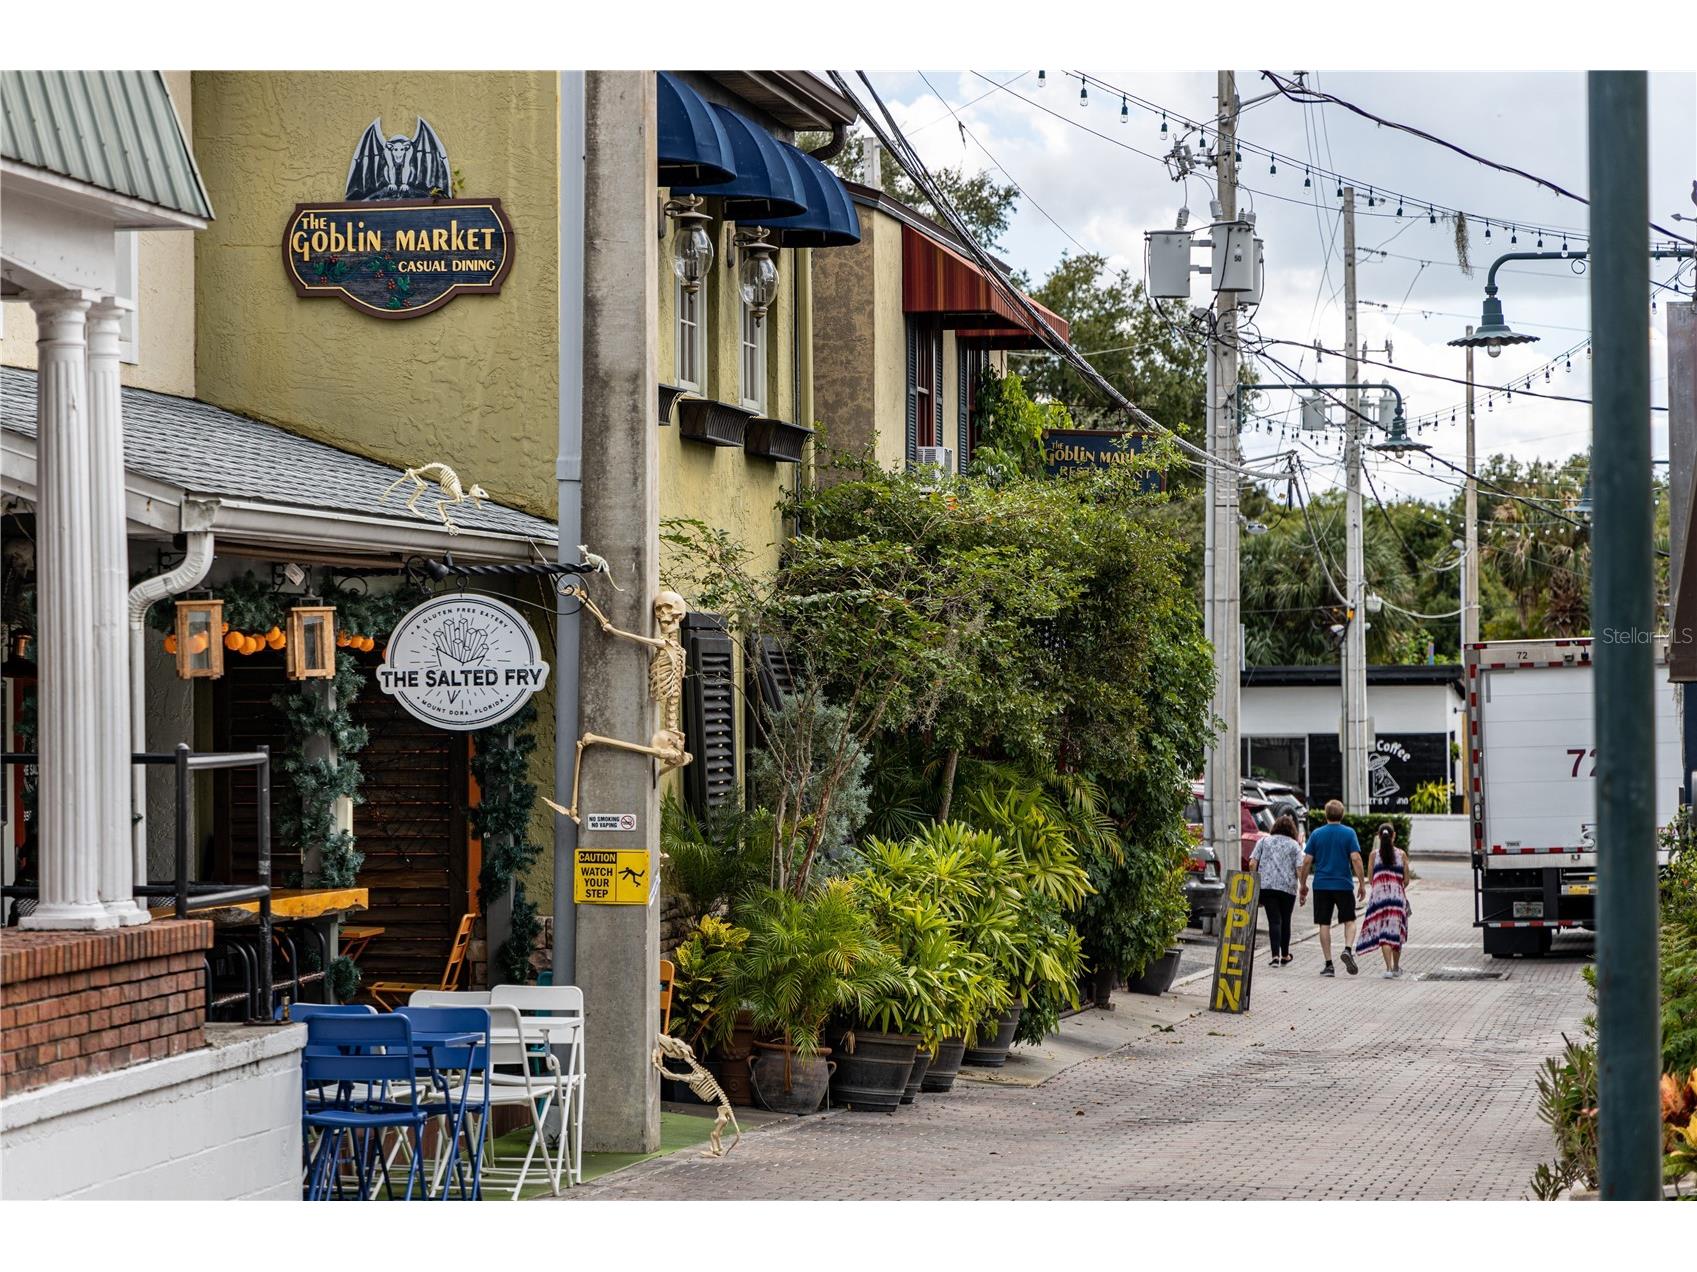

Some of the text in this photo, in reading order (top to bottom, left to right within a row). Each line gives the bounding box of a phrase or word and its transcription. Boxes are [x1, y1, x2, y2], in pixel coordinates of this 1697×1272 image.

[301, 213, 327, 230] THE
[396, 220, 496, 251] MARKET
[398, 260, 496, 272] CASUAL DINING
[1052, 440, 1064, 449] THE
[423, 609, 453, 624] GLUTEN
[480, 611, 509, 628] EATERY
[1516, 651, 1528, 660] 72
[381, 668, 543, 688] THE SALTED FRY
[421, 699, 446, 715] MOUNT
[474, 698, 504, 714] FLORIDA
[1376, 739, 1411, 762] Coffee
[579, 852, 616, 862] CAUTION
[581, 867, 613, 877] WATCH
[584, 878, 609, 887] YOUR
[585, 889, 608, 898] STEP
[1215, 873, 1255, 1011] OPEN
